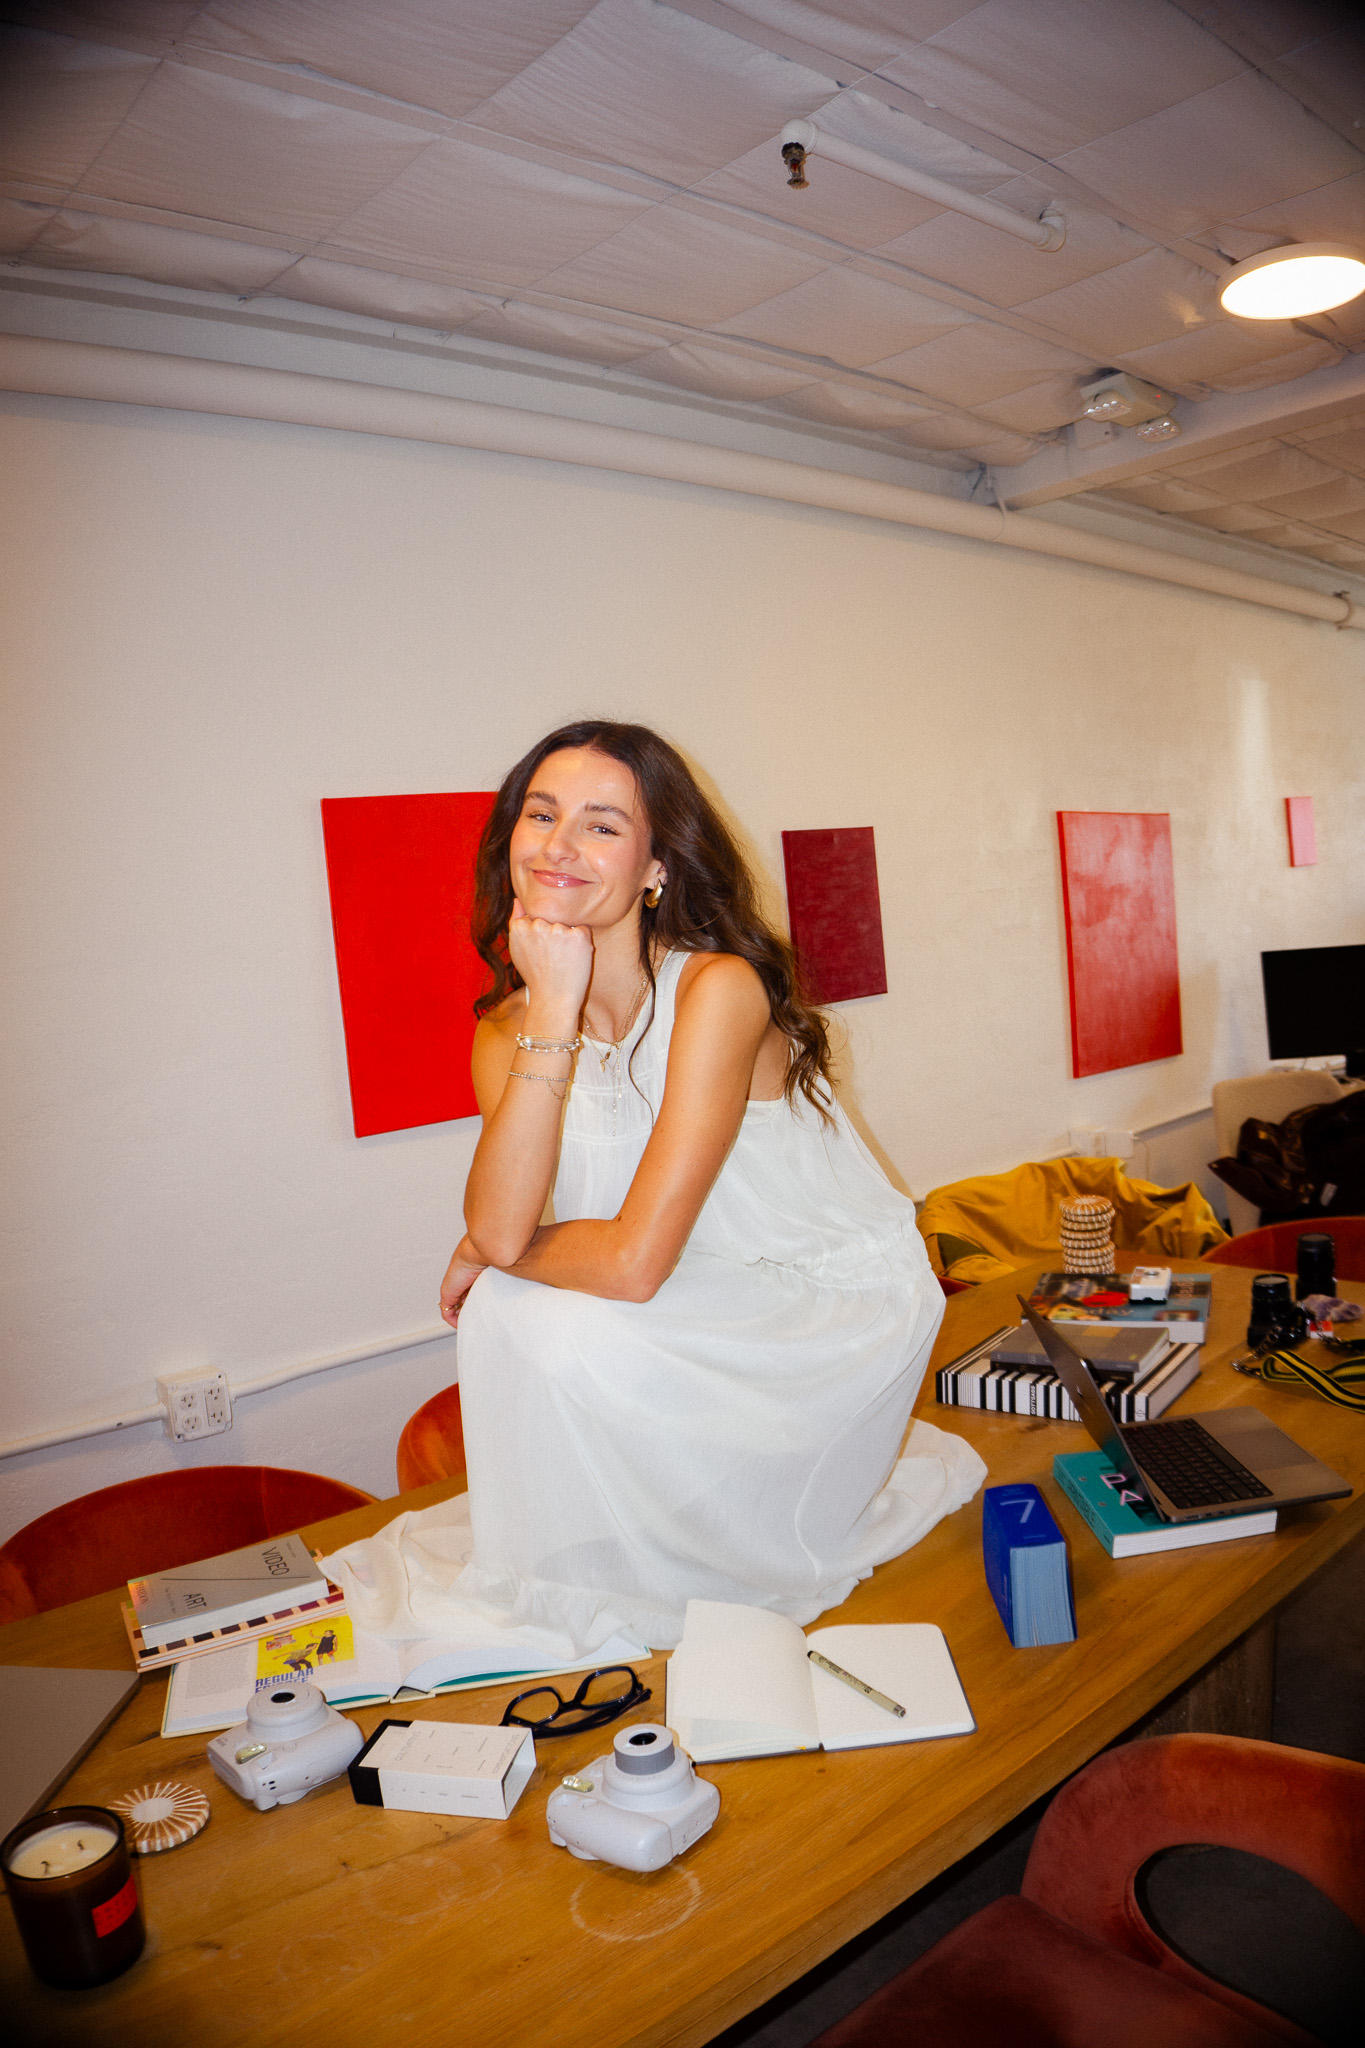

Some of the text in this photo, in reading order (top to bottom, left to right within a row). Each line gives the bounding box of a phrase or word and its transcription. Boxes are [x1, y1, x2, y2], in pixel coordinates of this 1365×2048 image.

[1029, 1384, 1037, 1416] SOTTSASS
[999, 1498, 1036, 1524] 7
[261, 1546, 290, 1577] VIDEO
[183, 1592, 207, 1610] ART
[255, 1668, 314, 1687] REGULAR
